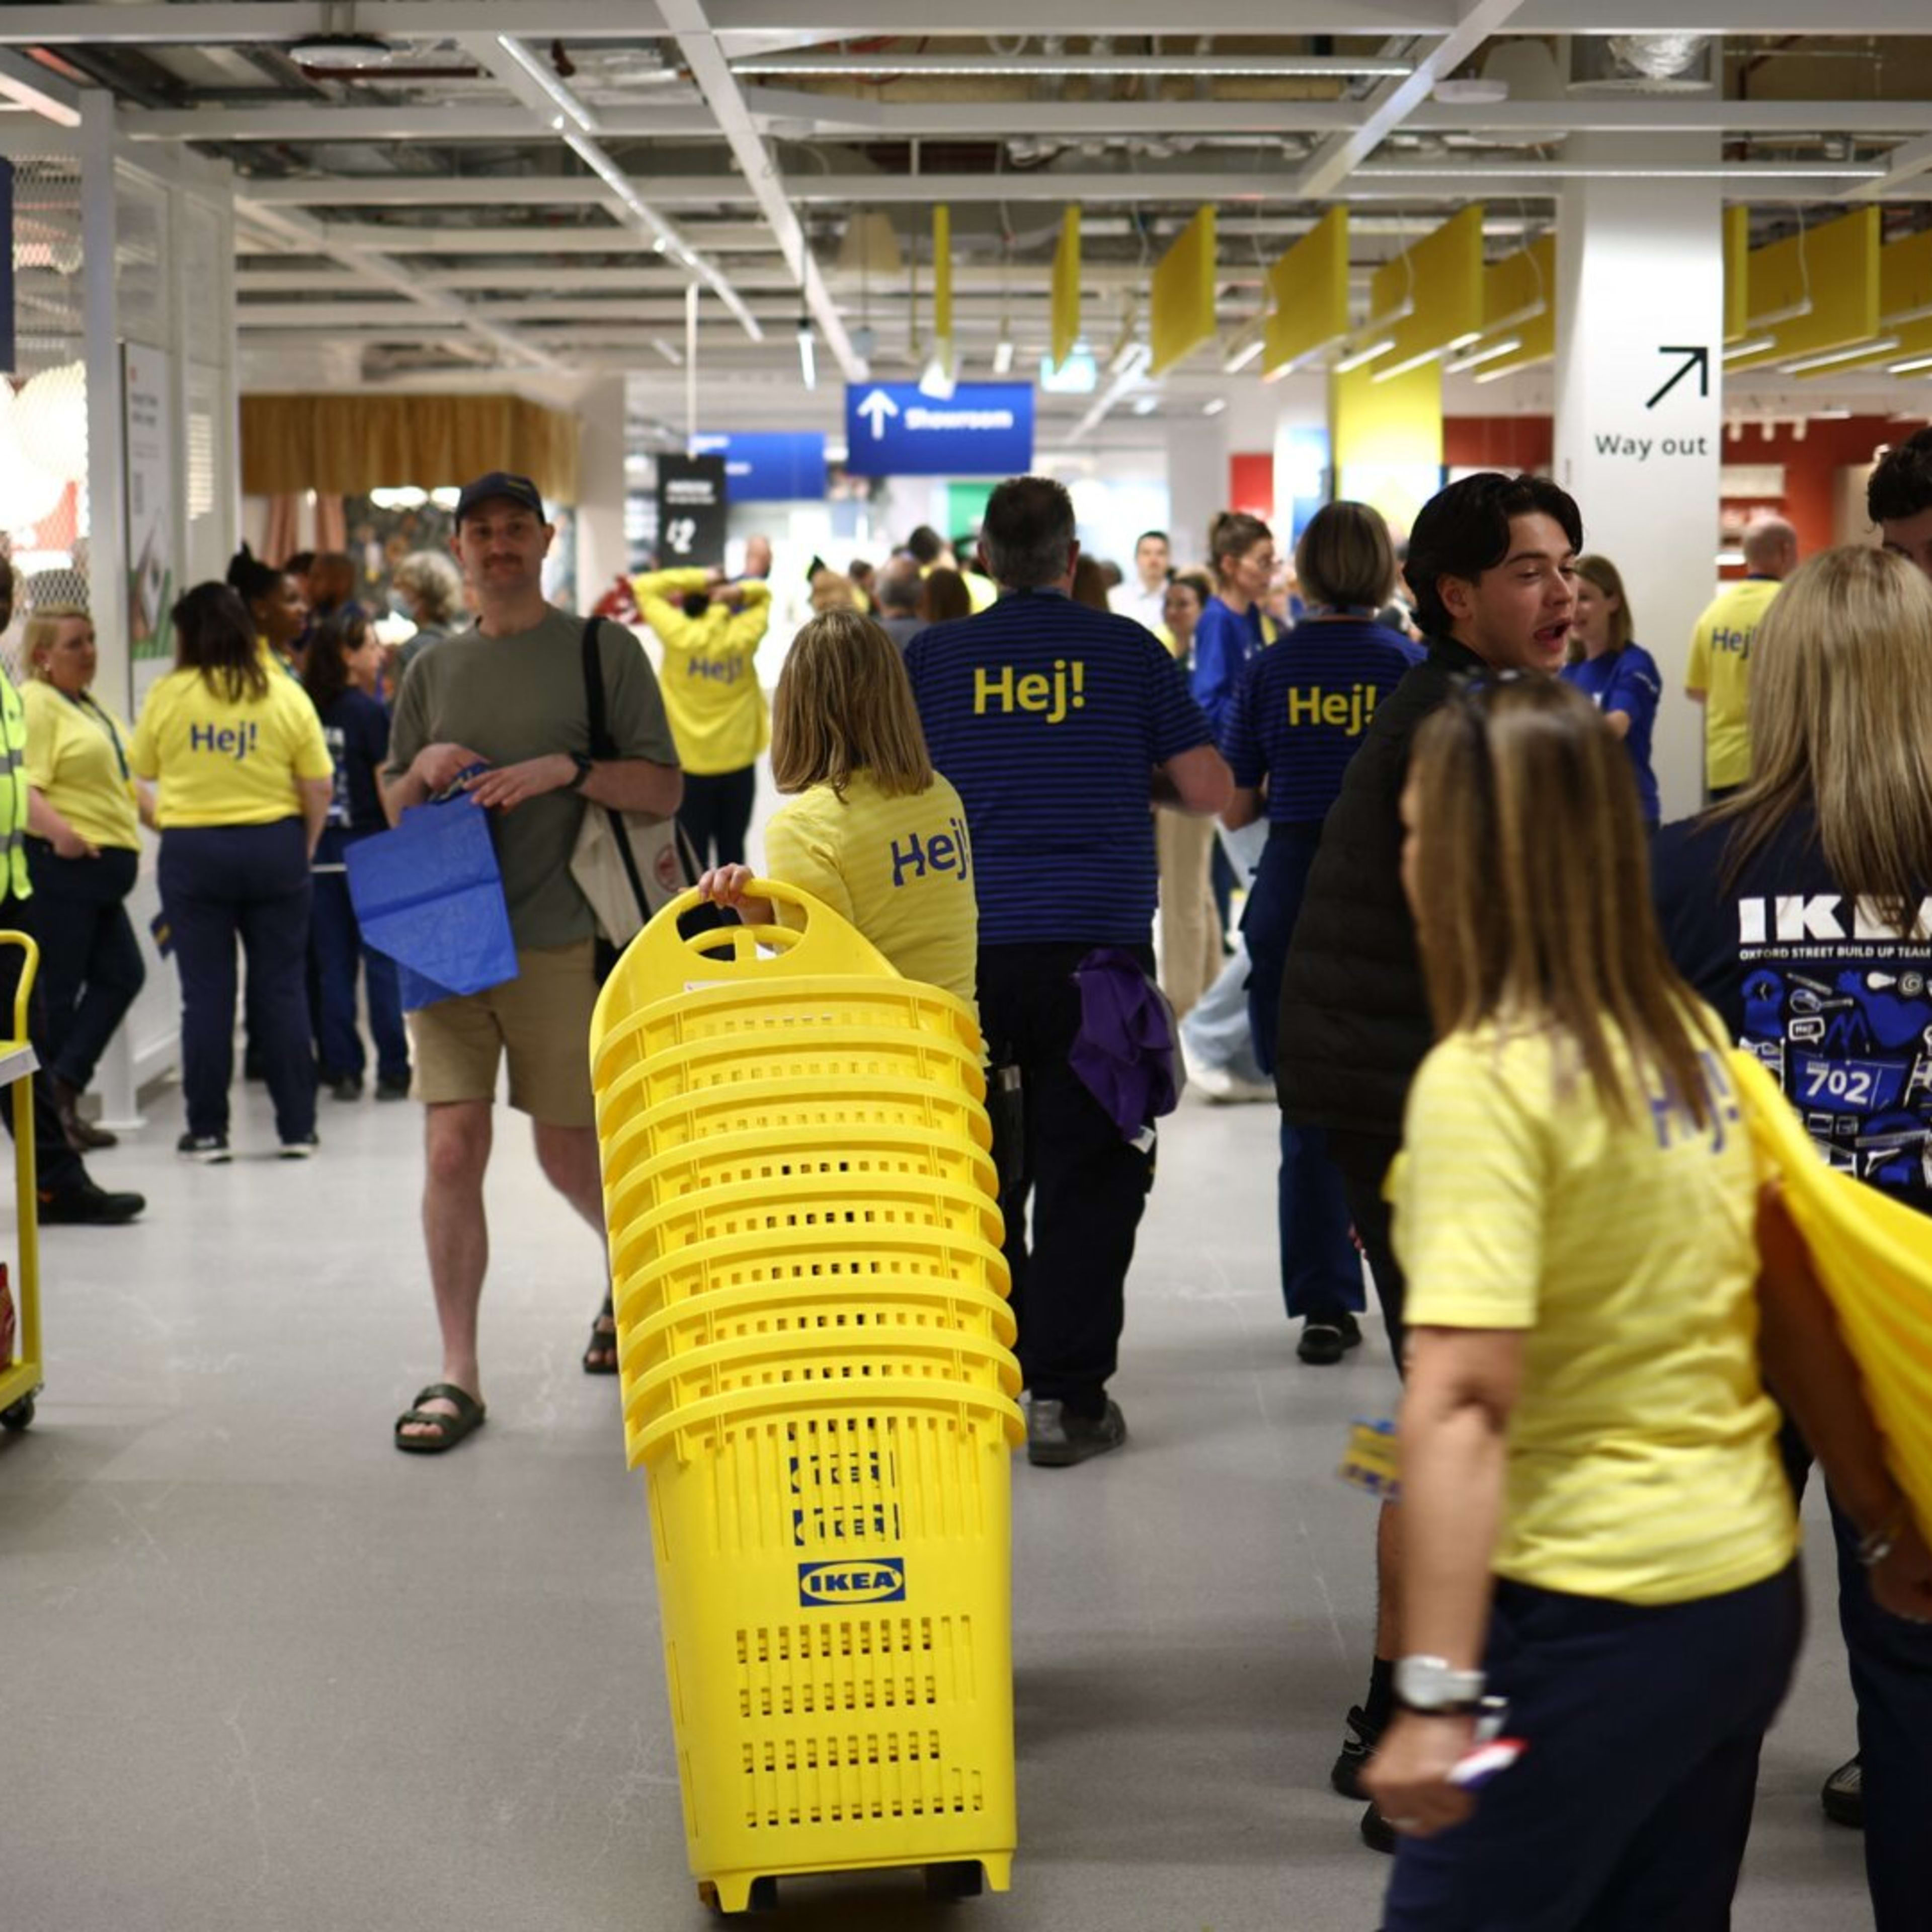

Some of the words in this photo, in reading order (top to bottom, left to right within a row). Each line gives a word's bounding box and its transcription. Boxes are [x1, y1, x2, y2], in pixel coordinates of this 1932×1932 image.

[905, 409, 1013, 429] Showroom
[1595, 435, 1652, 462] Way
[1661, 437, 1707, 455] out
[974, 659, 1085, 723] Hej!
[1289, 684, 1376, 736] Hej!
[191, 721, 257, 758] Hej!
[1739, 947, 1789, 960] OXFORD
[1792, 946, 1833, 958] STREET
[1837, 946, 1875, 957] BUILD
[1877, 946, 1895, 957] UP
[1806, 1066, 1871, 1105] 702
[810, 1571, 896, 1592] IKEA
